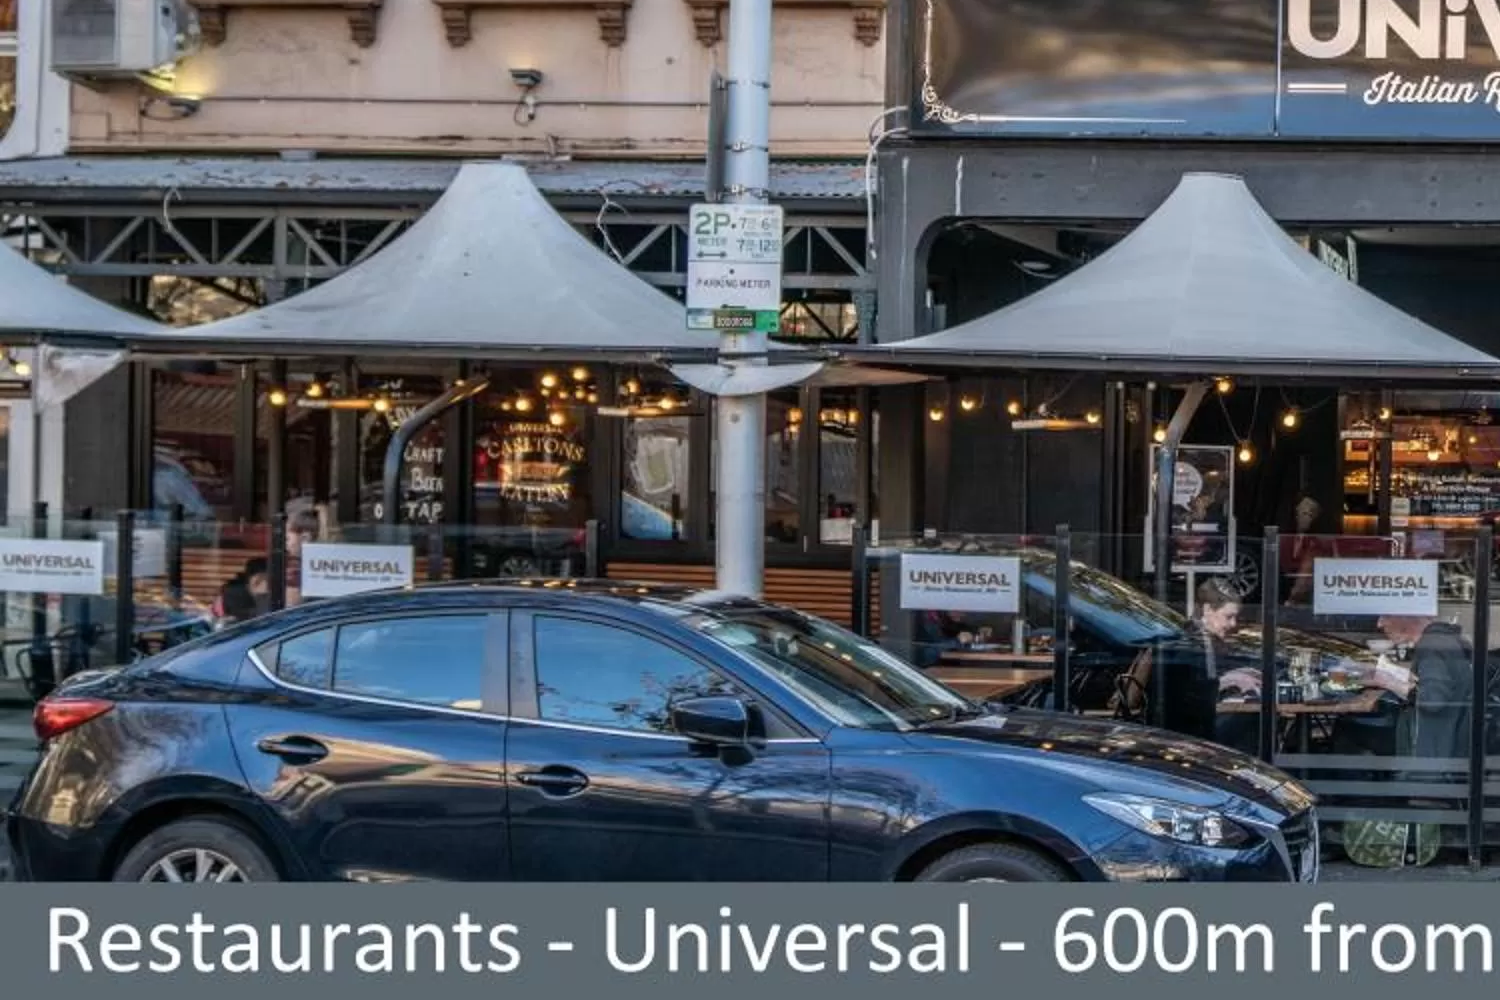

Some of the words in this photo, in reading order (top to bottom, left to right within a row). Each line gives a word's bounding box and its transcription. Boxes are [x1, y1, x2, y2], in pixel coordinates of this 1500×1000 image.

[1363, 71, 1480, 105] Italian
[695, 211, 731, 235] 2P
[696, 277, 738, 289] PARKING
[739, 279, 771, 289] METER
